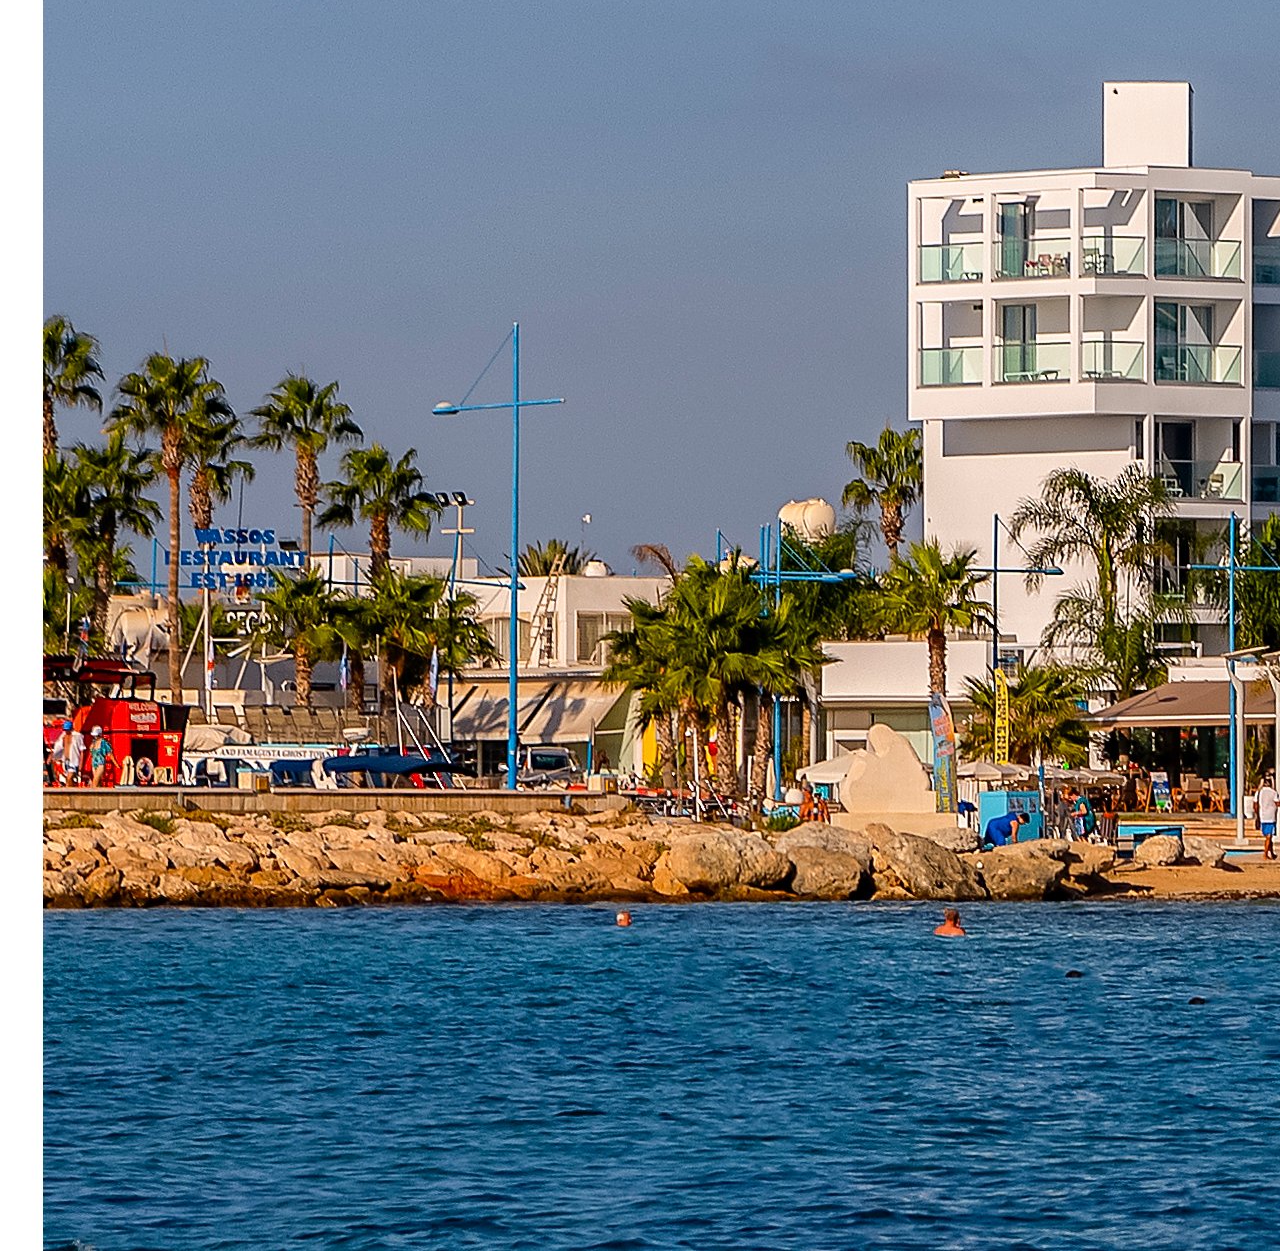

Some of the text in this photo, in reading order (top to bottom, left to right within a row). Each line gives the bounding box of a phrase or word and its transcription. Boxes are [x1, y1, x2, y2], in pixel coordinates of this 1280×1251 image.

[194, 528, 275, 545] VASSOS
[191, 572, 227, 589] EST
[237, 749, 281, 758] FAMAGUSTA
[282, 750, 307, 758] GHOST
